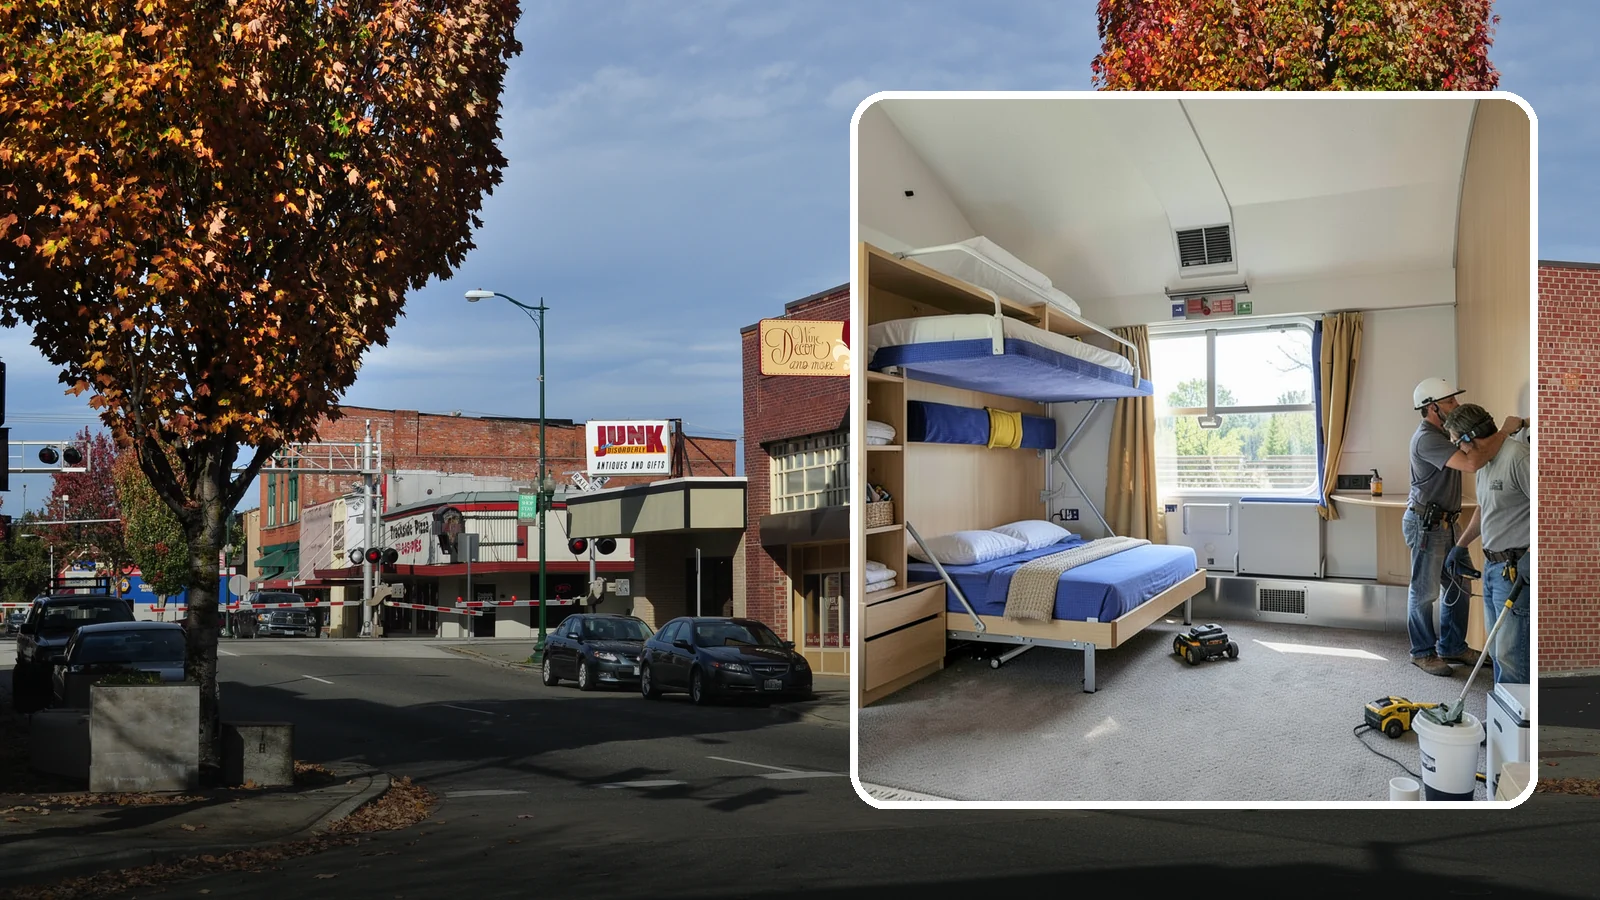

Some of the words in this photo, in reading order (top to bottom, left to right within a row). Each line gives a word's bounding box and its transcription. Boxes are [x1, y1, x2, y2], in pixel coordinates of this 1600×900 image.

[765, 327, 831, 366] Decor
[595, 425, 666, 458] JUNK
[607, 446, 646, 454] DISORDERLY
[597, 461, 628, 470] ANTIQUES
[631, 461, 644, 470] AND
[647, 460, 666, 470] GIFTS
[573, 473, 589, 493] RAIL
[390, 521, 413, 540] Trackside
[414, 519, 429, 535] Pizza
